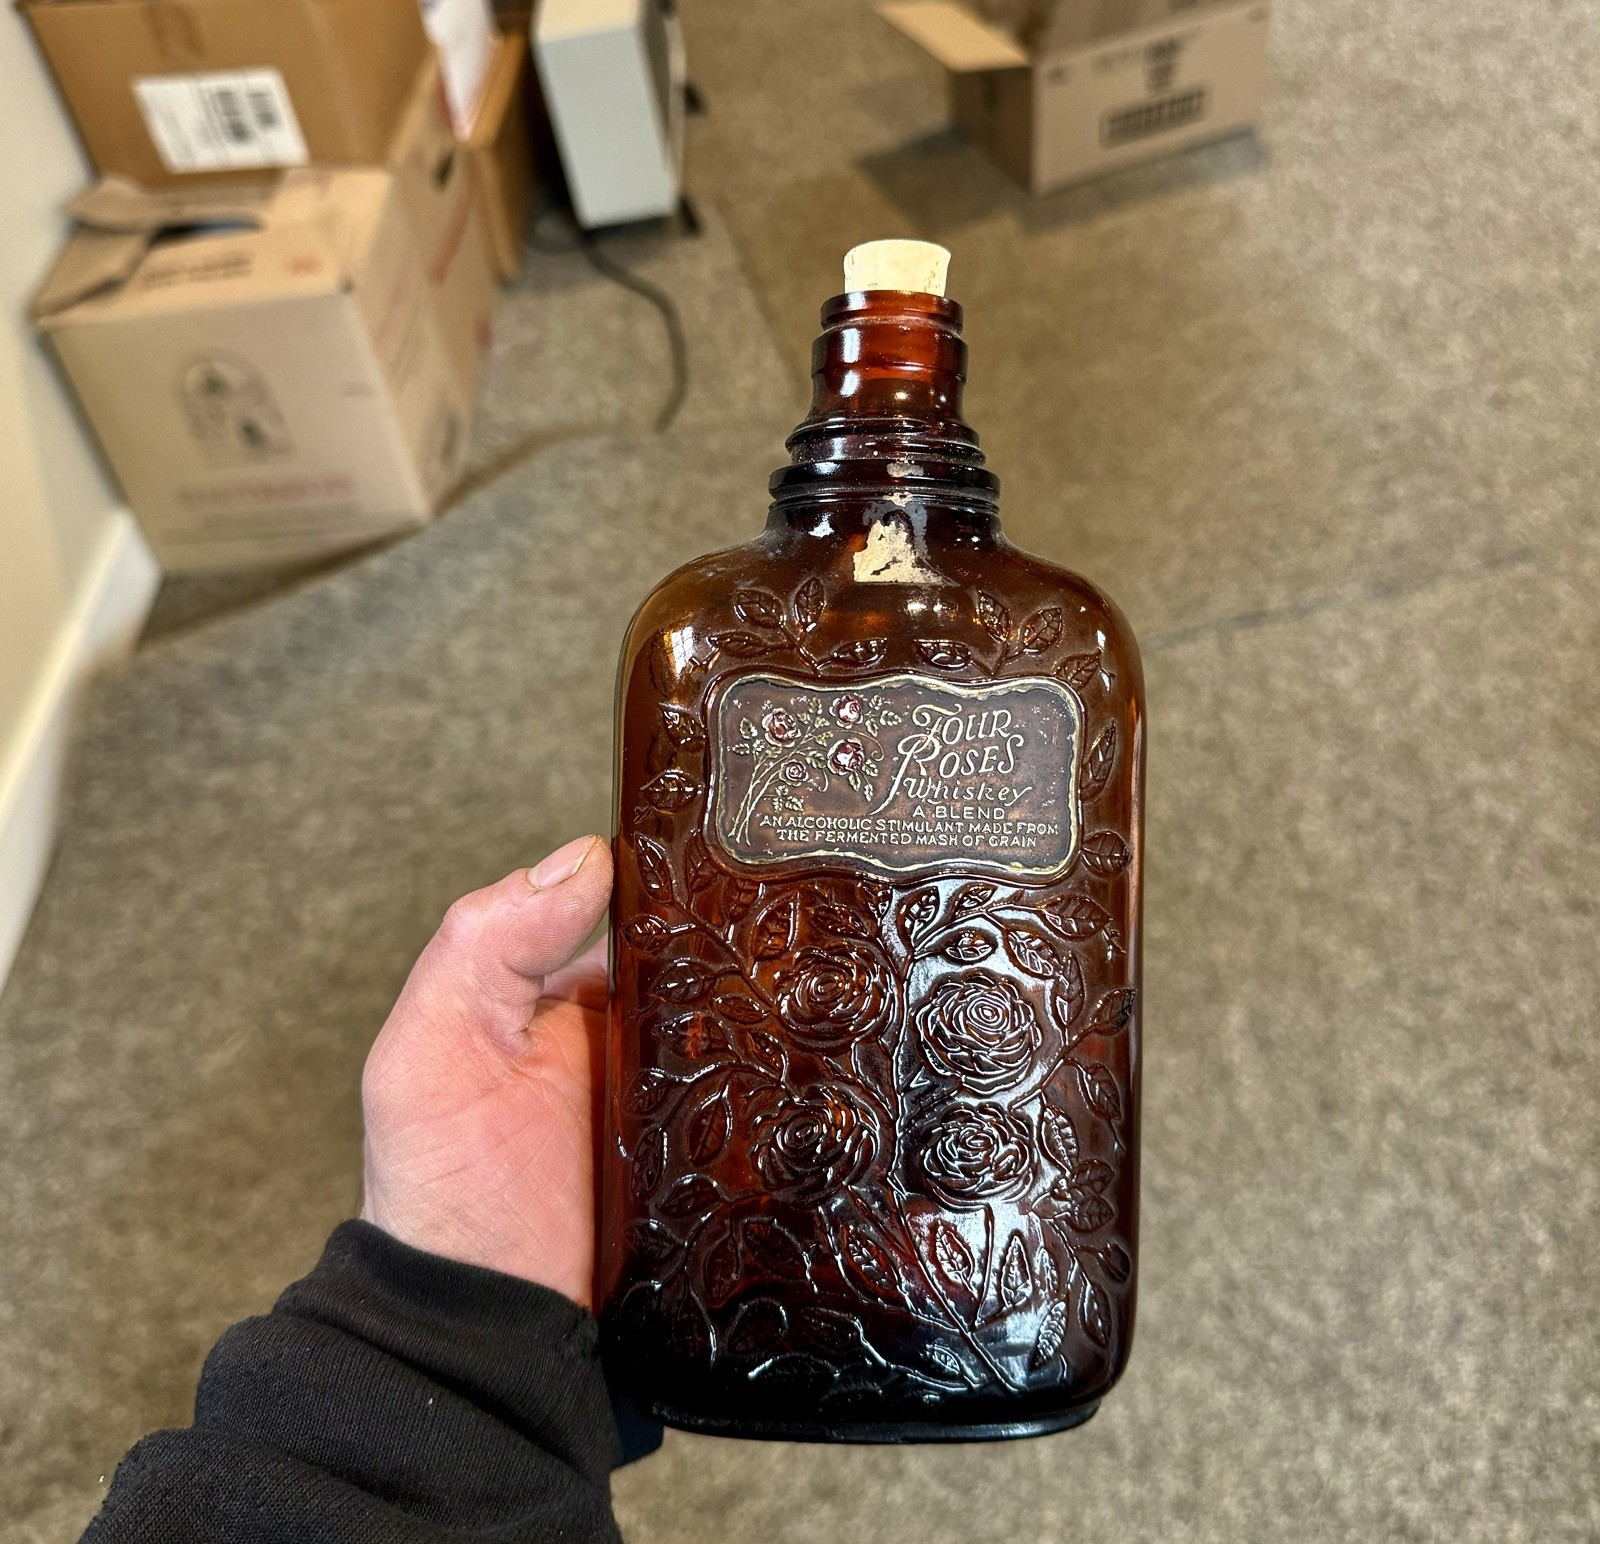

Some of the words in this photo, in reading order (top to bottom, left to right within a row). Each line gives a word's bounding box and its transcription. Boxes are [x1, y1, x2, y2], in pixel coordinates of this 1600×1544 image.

[912, 703, 1012, 745] FOUR
[868, 733, 1024, 815] ROSES
[902, 776, 1032, 806] Whiskey
[760, 815, 782, 828] AN
[785, 817, 872, 831] ALCOHOLIC
[875, 819, 963, 834] STIMULANT
[968, 822, 1012, 835] MADE
[1016, 822, 1059, 835] FROM
[912, 805, 925, 818] A
[935, 806, 1005, 820] BLEND
[776, 829, 810, 842] THE
[815, 830, 912, 845] FERMENTED
[915, 834, 958, 846] MASH
[962, 835, 985, 847] OF
[988, 835, 1037, 848] GRAIN
